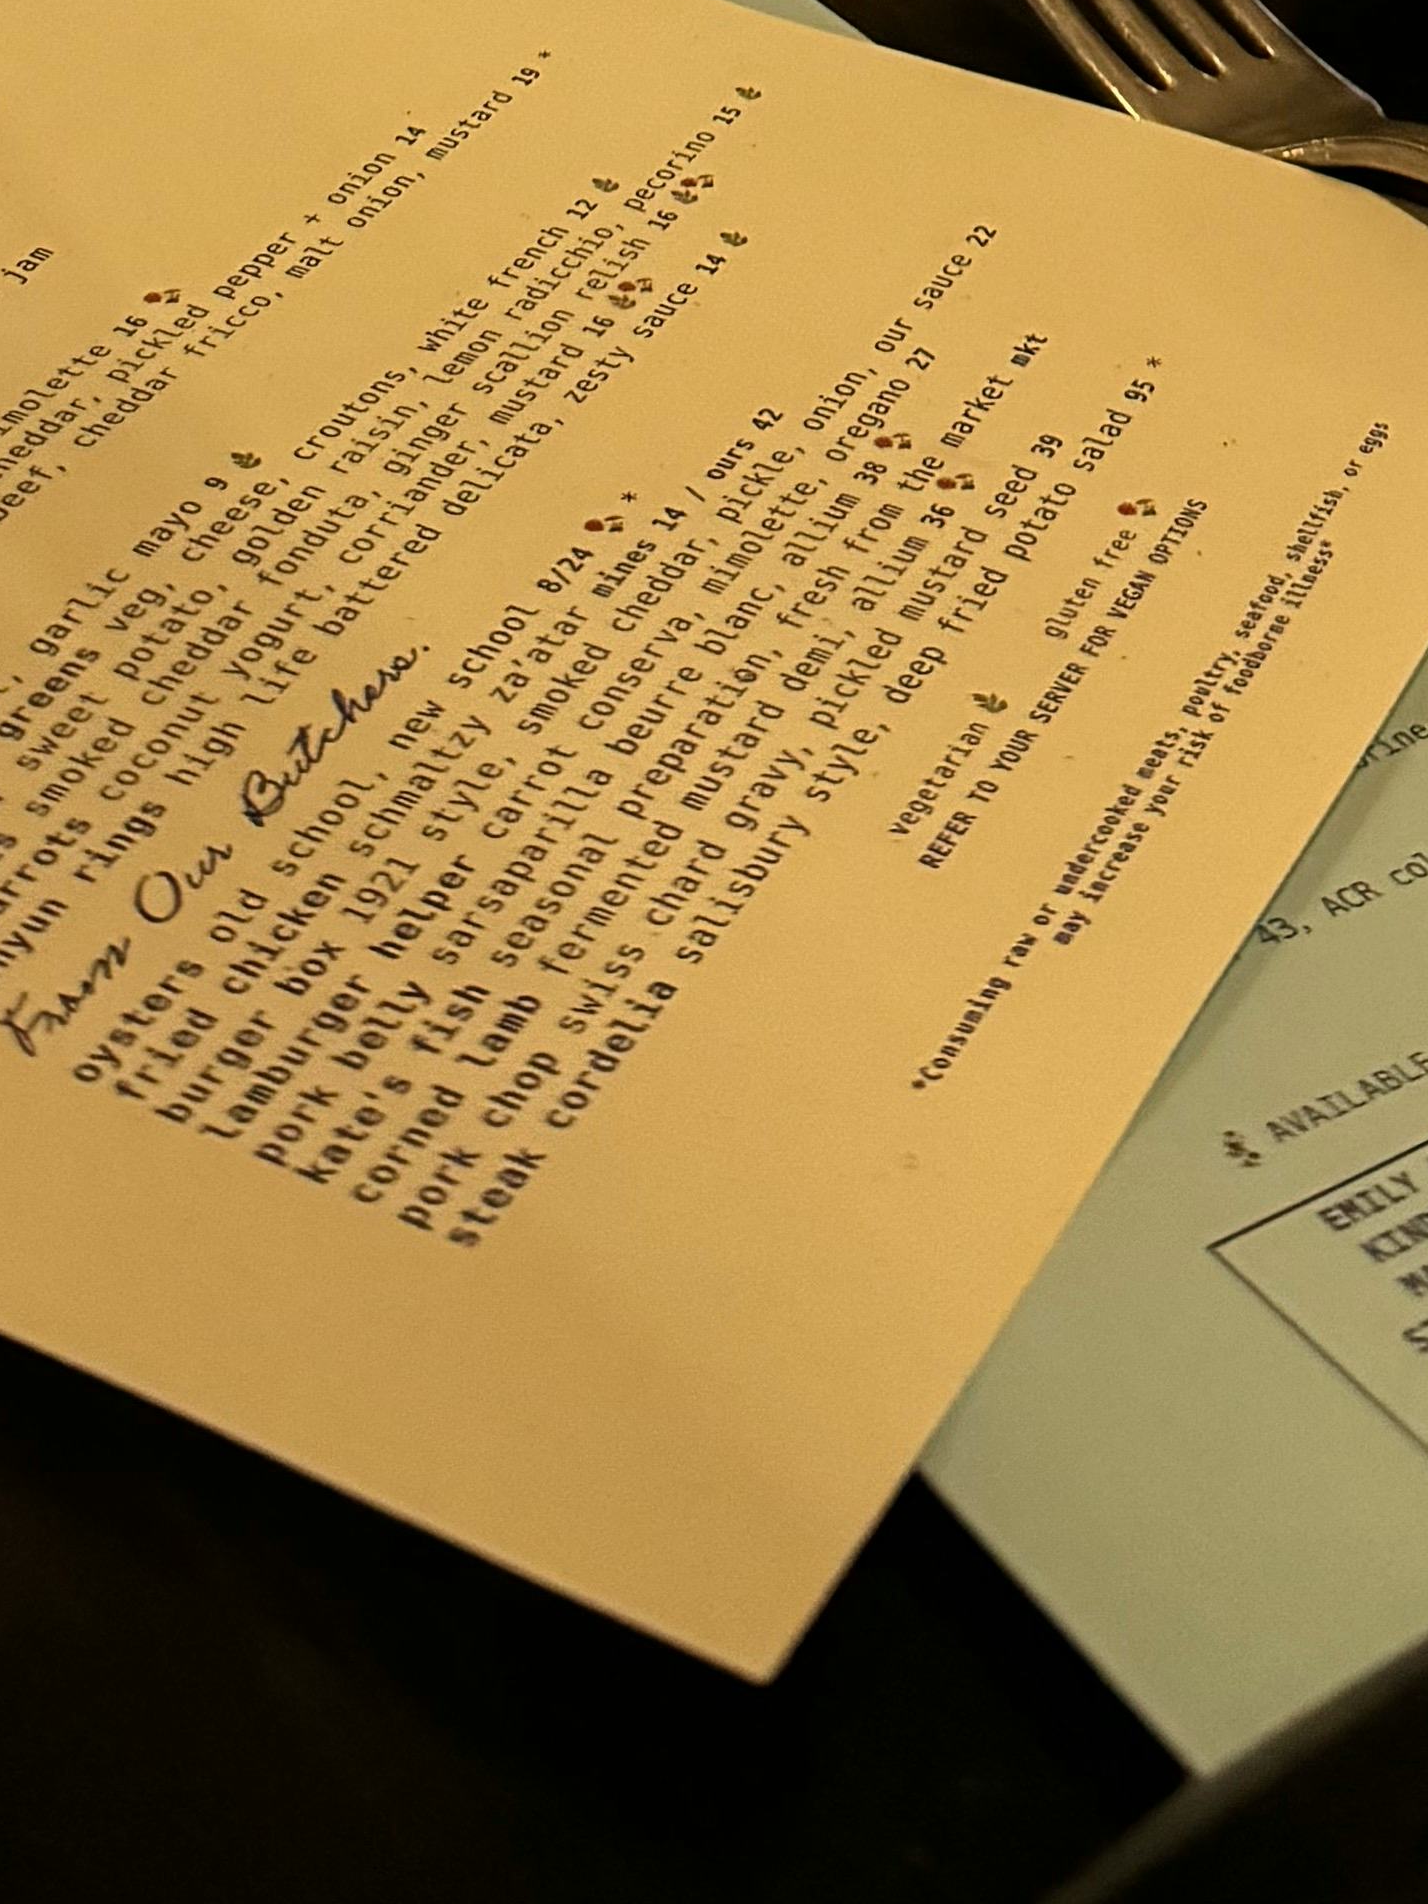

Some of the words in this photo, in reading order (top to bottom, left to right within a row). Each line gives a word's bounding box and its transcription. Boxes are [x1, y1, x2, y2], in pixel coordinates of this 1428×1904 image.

[105, 303, 210, 384] pickled
[212, 232, 296, 300] pepper
[327, 153, 396, 205] onion
[394, 126, 427, 146] 14
[112, 315, 148, 337] 16
[28, 568, 130, 657] garlic
[132, 501, 203, 558] mayo
[203, 477, 229, 491] 9
[888, 722, 989, 835] vegetarian
[1044, 578, 1101, 640] gluten
[1092, 530, 1137, 569] free
[917, 811, 977, 869] REFER
[966, 780, 999, 803] TO
[988, 729, 1039, 772] YOUR
[1028, 662, 1089, 724] SERVER
[1079, 625, 1117, 658] FOR
[1106, 570, 1156, 619] VEGAN
[1147, 499, 1208, 565] OPTIONS
[72, 960, 205, 1083] oysters
[207, 888, 269, 943] old
[271, 772, 389, 877] school,
[387, 700, 446, 751] new
[446, 604, 541, 689] school
[535, 547, 595, 593] 8/24
[133, 844, 233, 924] Our
[240, 645, 430, 828] Butchers.
[198, 974, 371, 1139] lamburger
[366, 854, 476, 960] helper
[481, 745, 578, 839] carrot
[577, 612, 705, 730] conserva,
[701, 478, 828, 595] mimolette,
[825, 378, 911, 462] oregano
[904, 347, 936, 371] 27
[1321, 881, 1383, 917] ACR
[1316, 1171, 1420, 1232] EMILY
